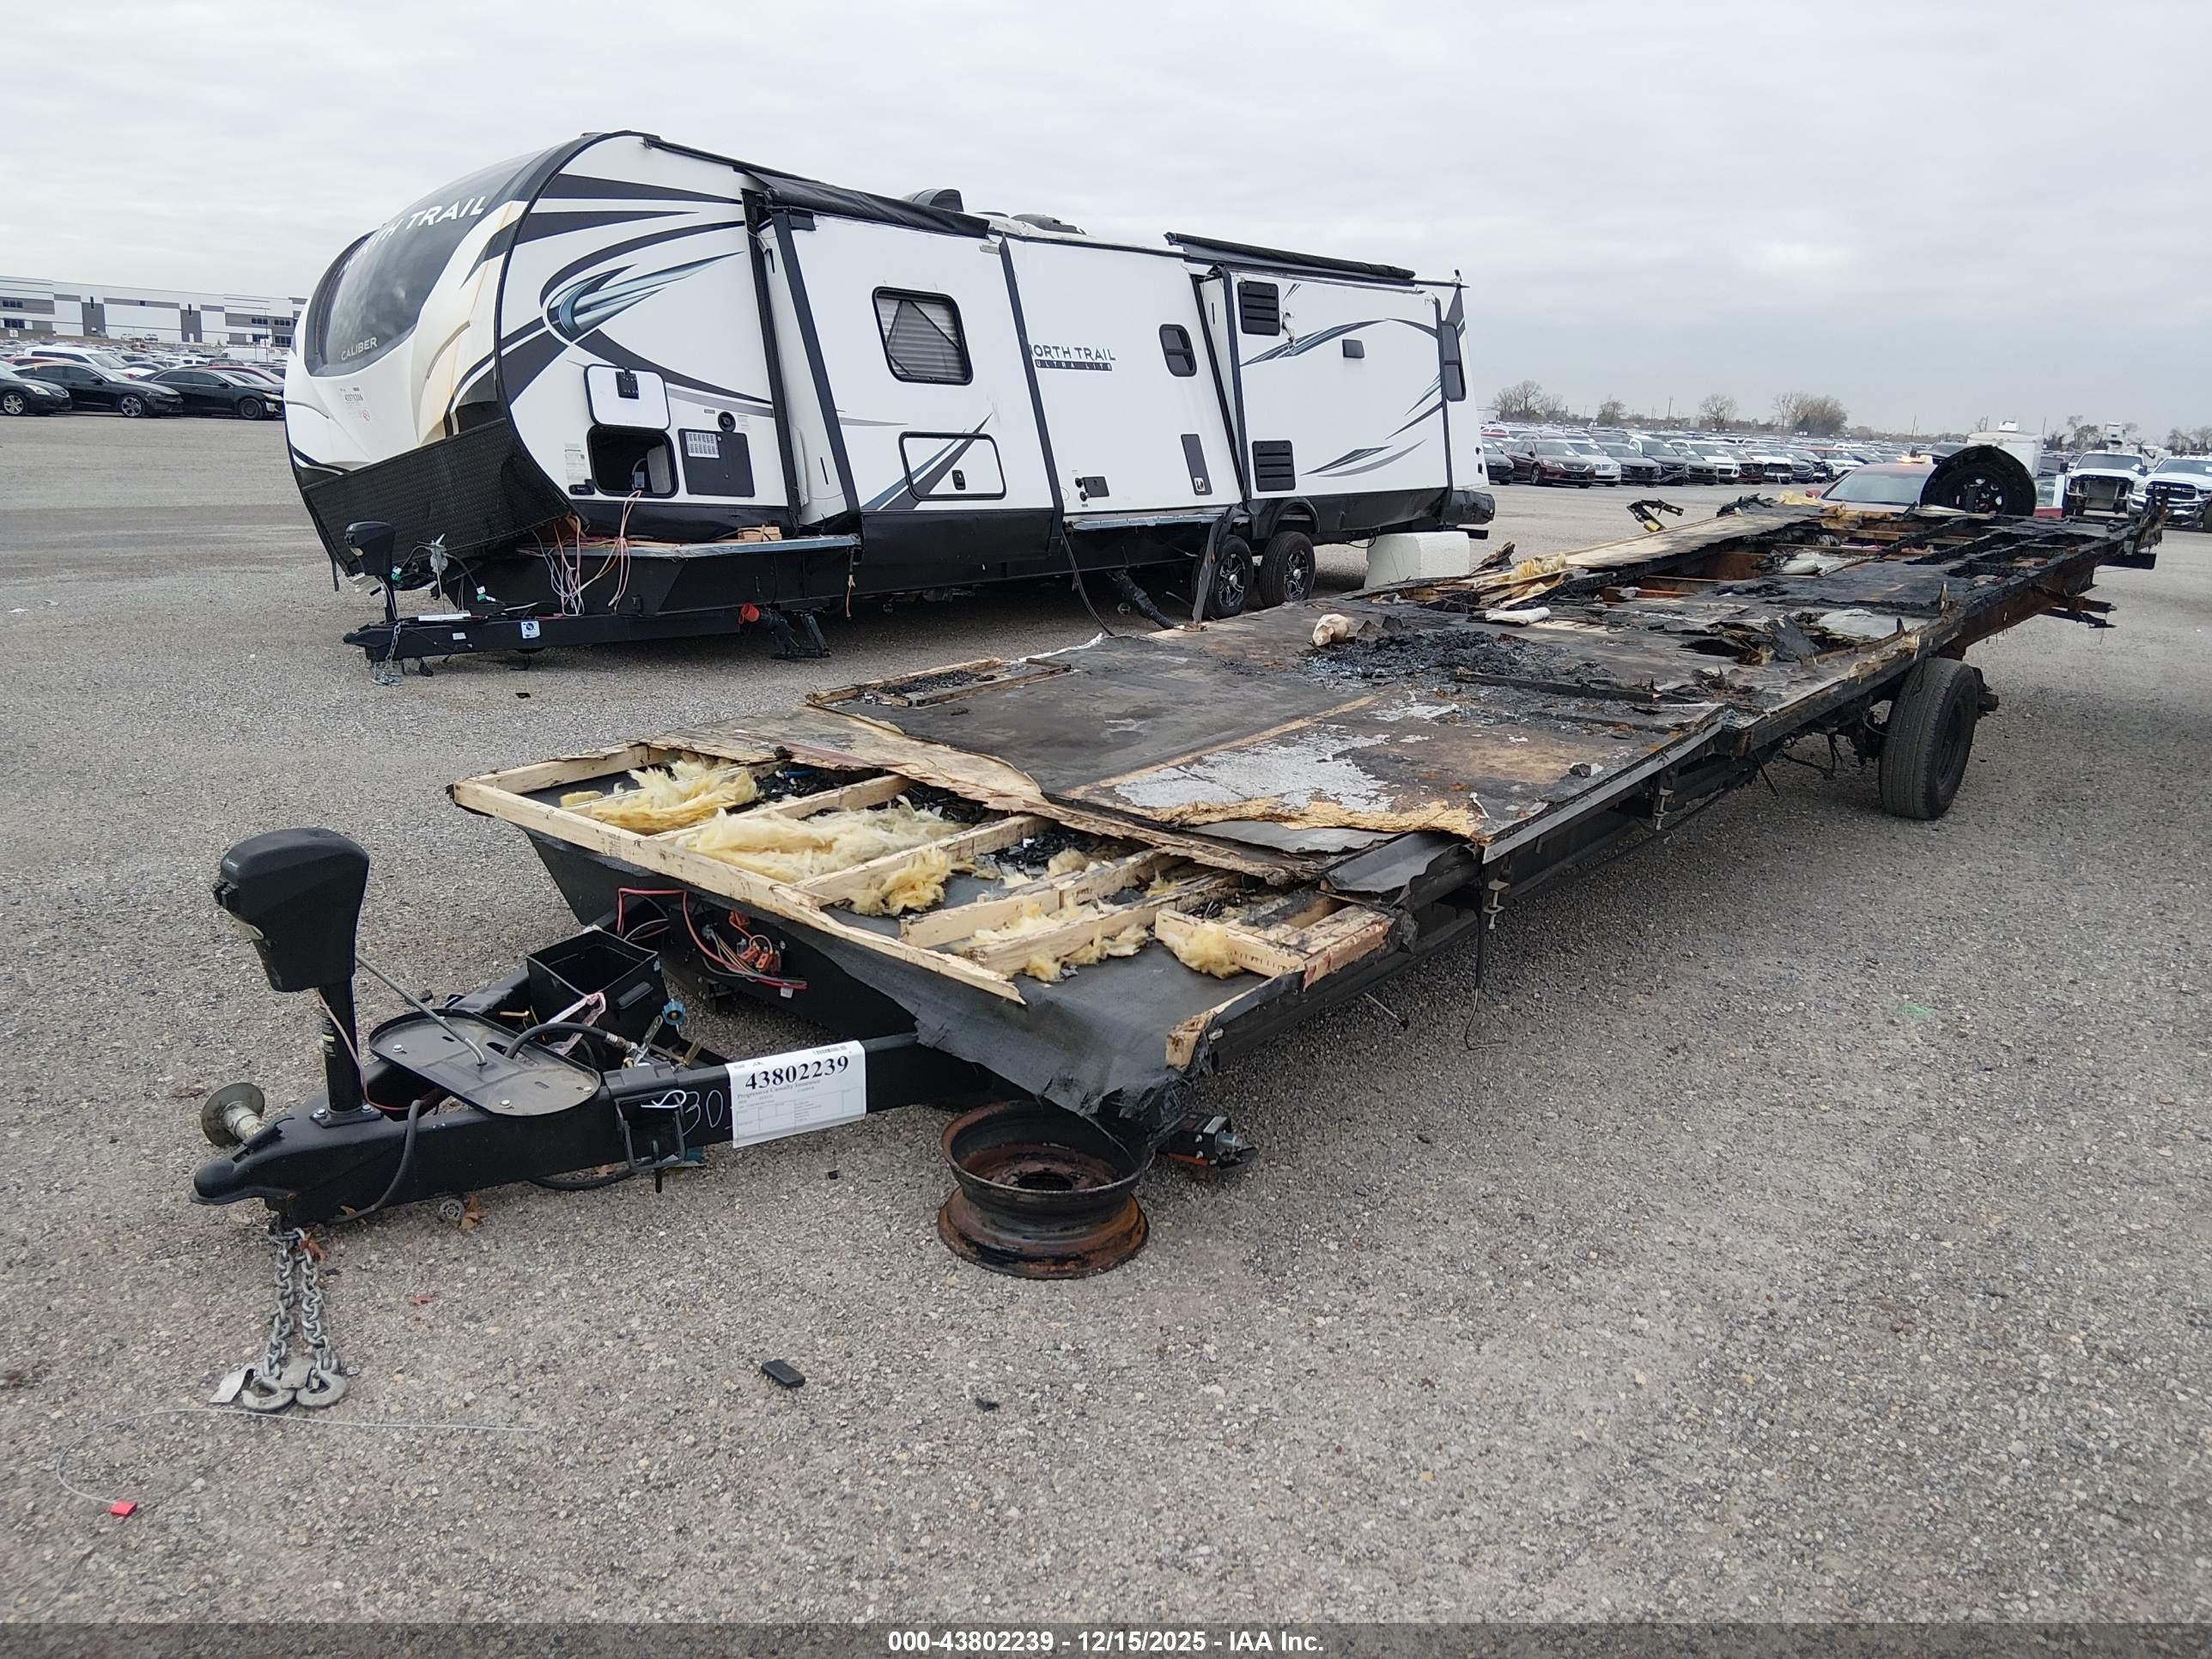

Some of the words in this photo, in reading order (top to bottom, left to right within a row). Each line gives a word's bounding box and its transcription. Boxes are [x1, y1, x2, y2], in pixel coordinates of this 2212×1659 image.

[405, 196, 487, 230] TRAIL
[341, 336, 378, 361] CALIBER
[1073, 347, 1116, 361] TRAIL
[744, 1054, 849, 1091] 43802239
